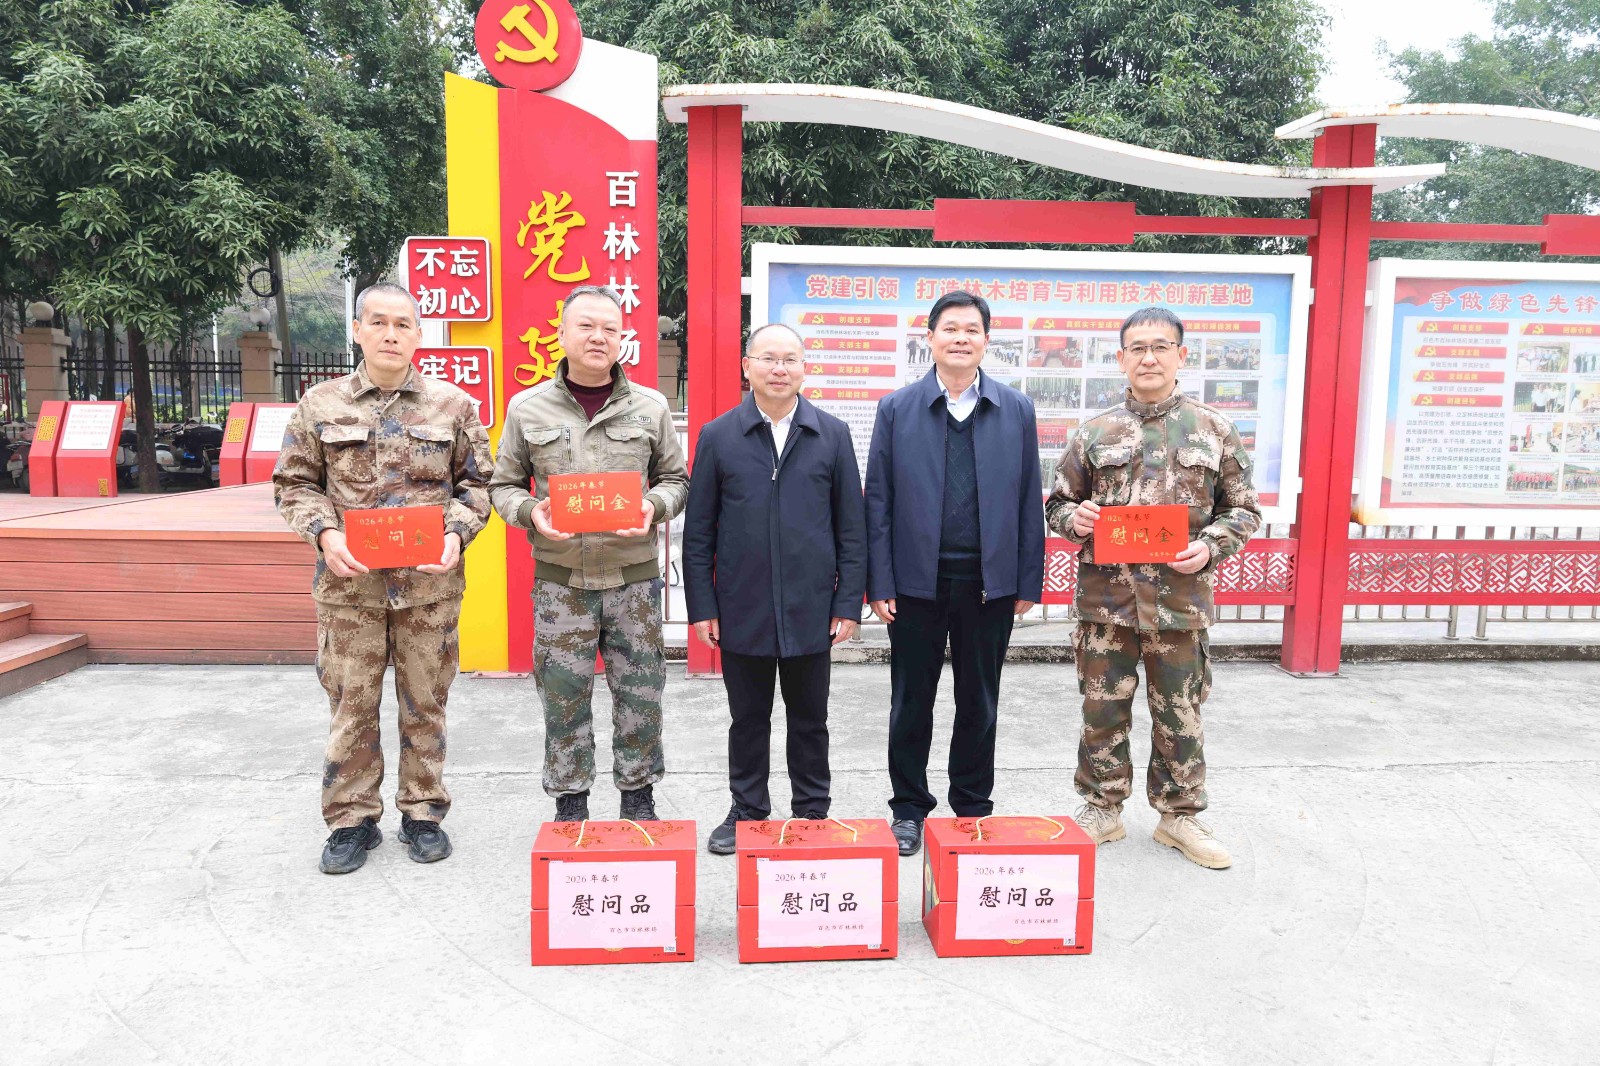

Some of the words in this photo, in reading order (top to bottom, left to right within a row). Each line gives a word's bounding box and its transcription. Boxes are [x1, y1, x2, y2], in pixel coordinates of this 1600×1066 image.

[415, 246, 480, 277] 不忘
[416, 284, 481, 315] 初心
[807, 274, 899, 299] 党建引领
[916, 277, 1254, 305] 打造林木培育与利用技术创新基地
[1430, 292, 1599, 314] 争做绿色先锋
[419, 355, 481, 385] 牢记
[558, 480, 605, 491] 2026年春节
[566, 493, 631, 514] 慰问金
[1109, 525, 1175, 545] 慰问金
[565, 875, 587, 884] 2026
[591, 874, 619, 884] 年春节
[775, 873, 796, 882] 2026
[799, 872, 827, 881] 年春节
[974, 867, 994, 876] 2026
[998, 866, 1025, 875] 年春节
[572, 894, 651, 917] 慰问品
[781, 892, 858, 915] 慰问品
[979, 886, 1054, 908] 慰问品
